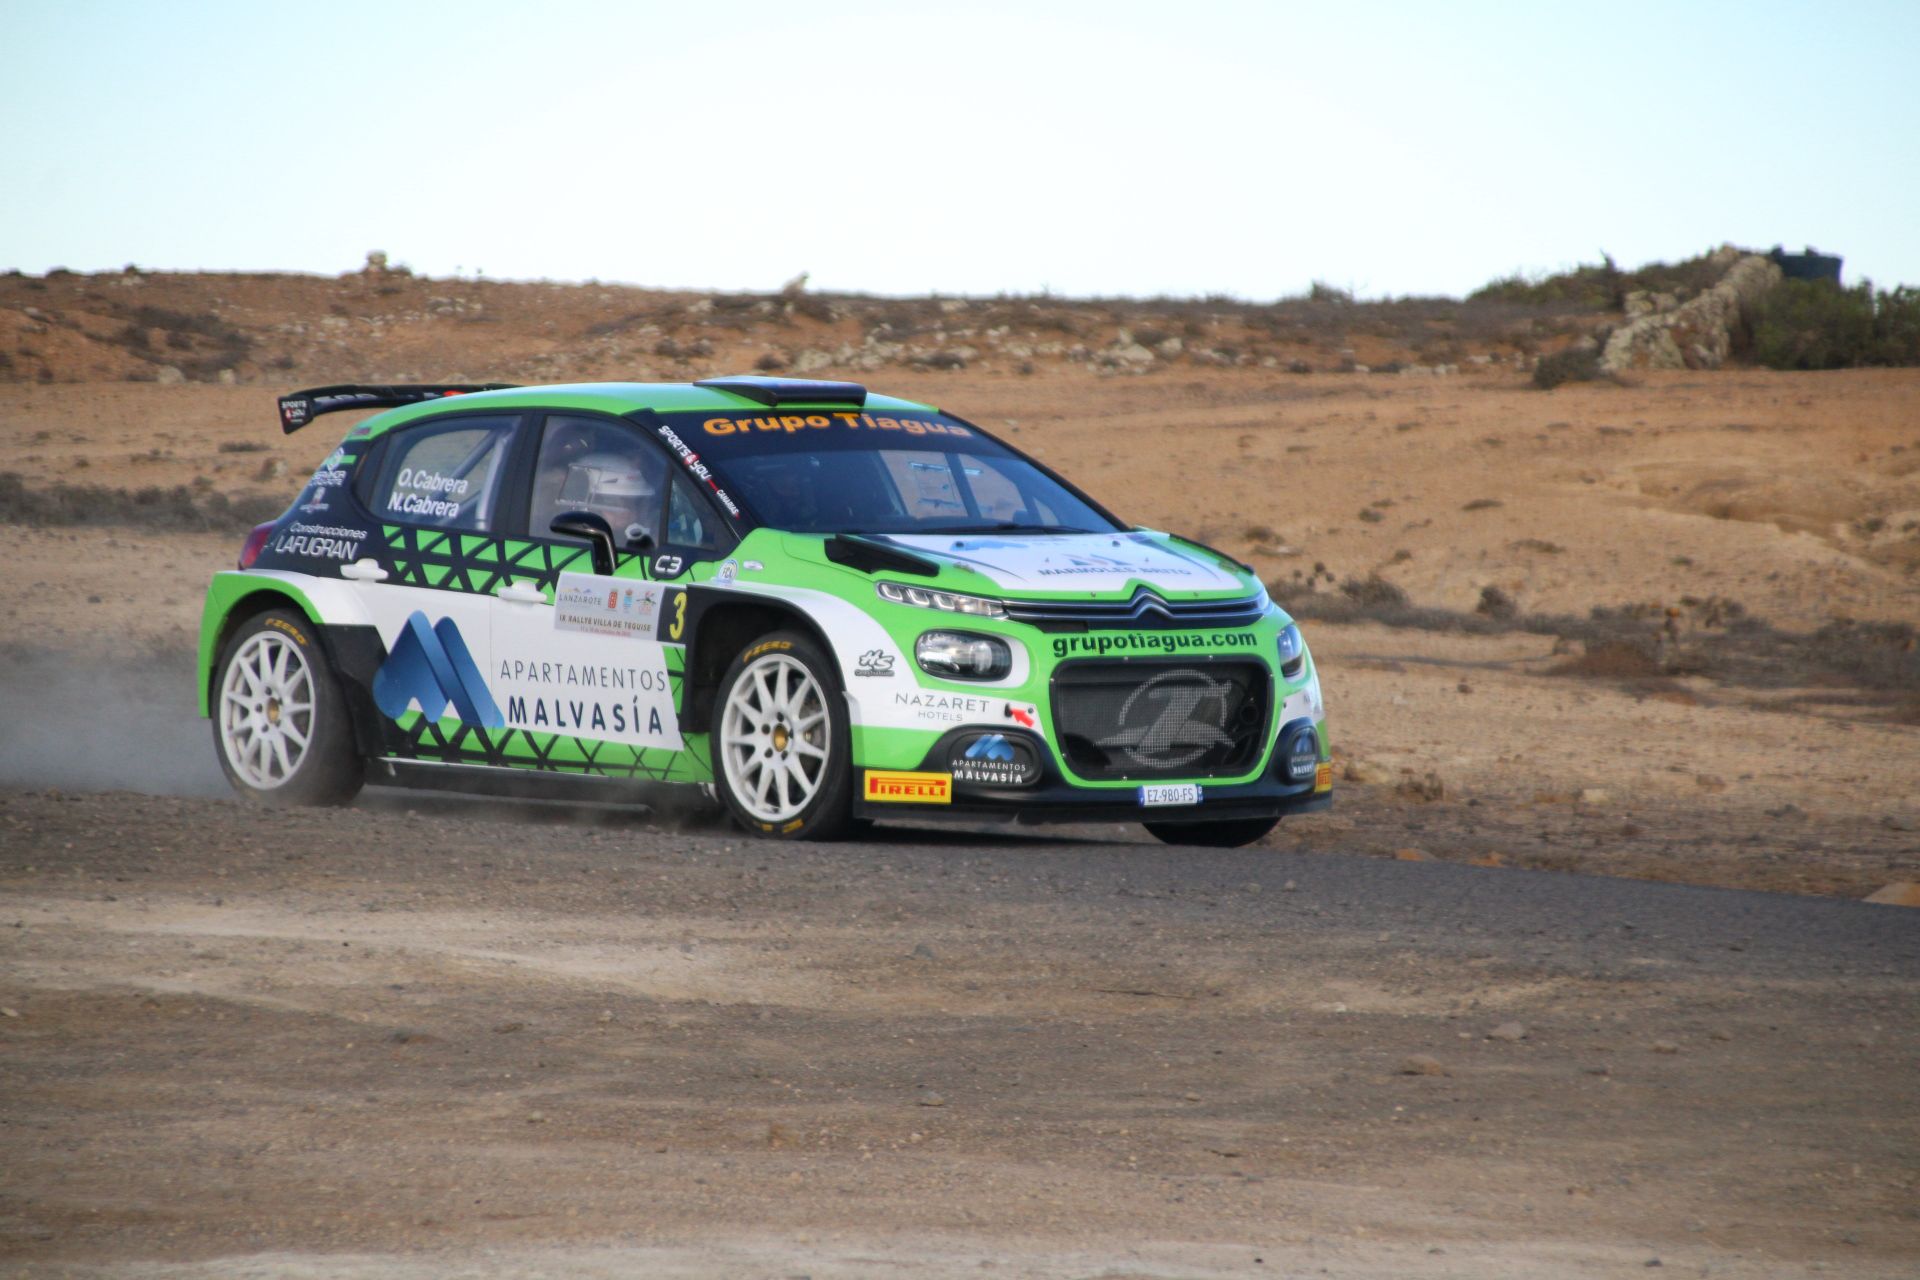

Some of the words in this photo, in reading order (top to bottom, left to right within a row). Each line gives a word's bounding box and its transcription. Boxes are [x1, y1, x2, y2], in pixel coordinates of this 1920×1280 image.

[703, 415, 830, 435] Grupo
[833, 412, 972, 437] Tiagua
[289, 522, 368, 540] Construcciones
[274, 535, 358, 561] LAFUGRAN
[655, 555, 683, 574] C3
[1038, 566, 1136, 576] MARMOLES
[558, 593, 602, 606] LANZAROTE
[568, 615, 592, 625] RALLYE
[593, 618, 612, 627] VILLA
[613, 620, 622, 628] DE
[669, 592, 687, 640] 3
[1052, 632, 1258, 658] grupotiagua.com
[500, 660, 666, 692] APARTAMENTOS
[895, 692, 990, 712] NAZARET
[508, 694, 663, 735] MALVASÍA
[918, 711, 963, 721] HOTELS
[952, 760, 1026, 771] APARTAMENTOS
[953, 769, 1023, 784] MALVASÍA
[869, 777, 947, 796] PIRELLI
[1147, 788, 1194, 802] EZ-980-FS
